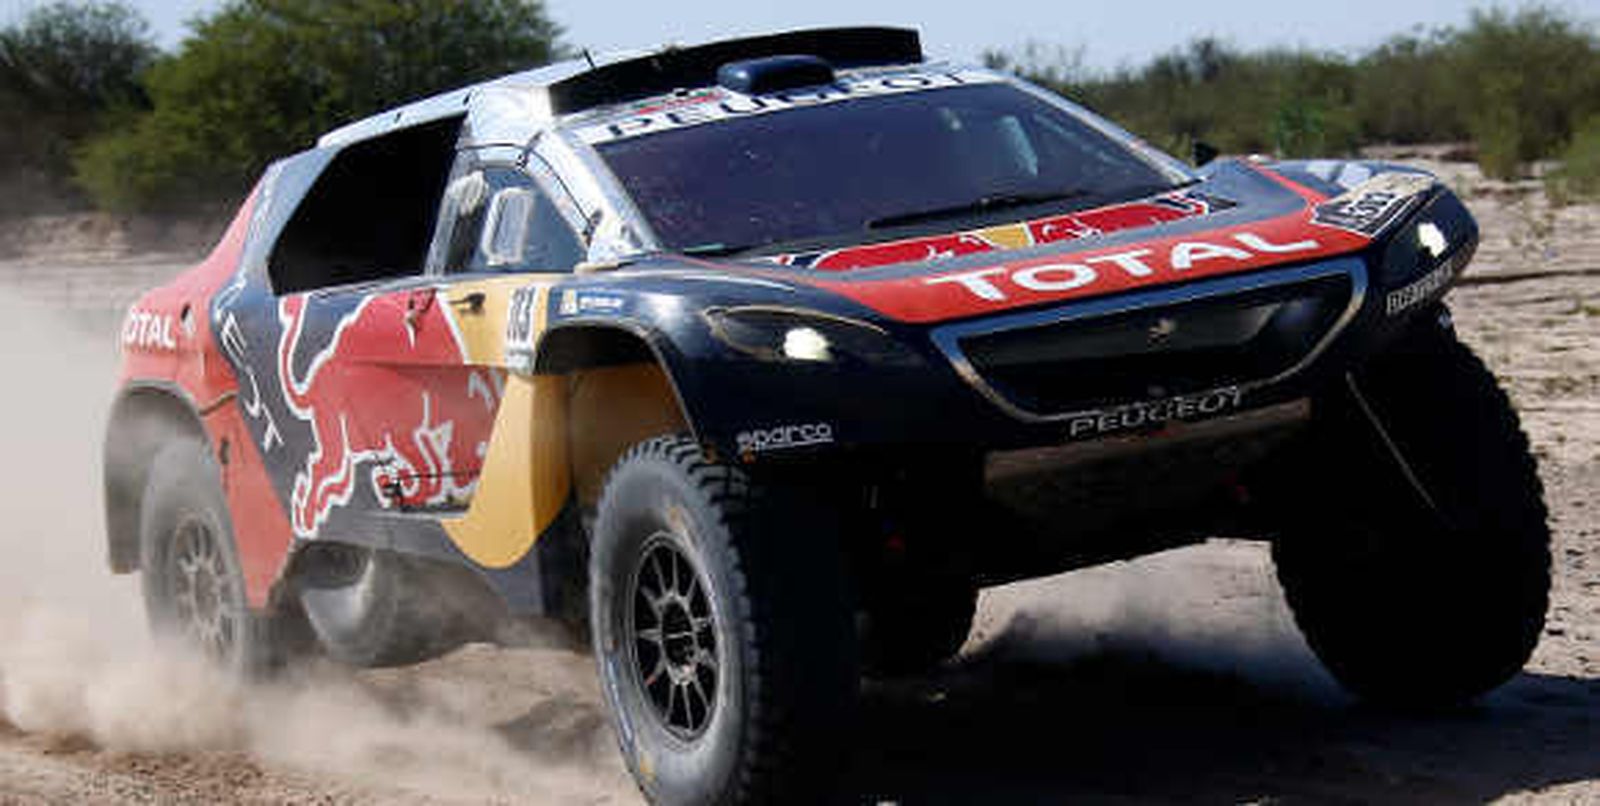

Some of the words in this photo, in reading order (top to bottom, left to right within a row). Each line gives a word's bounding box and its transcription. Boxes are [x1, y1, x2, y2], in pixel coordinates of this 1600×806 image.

[926, 232, 1320, 301] TOTAL
[122, 306, 177, 349] OTAL
[1069, 386, 1241, 437] PEUGEOT
[736, 422, 834, 454] sparco
